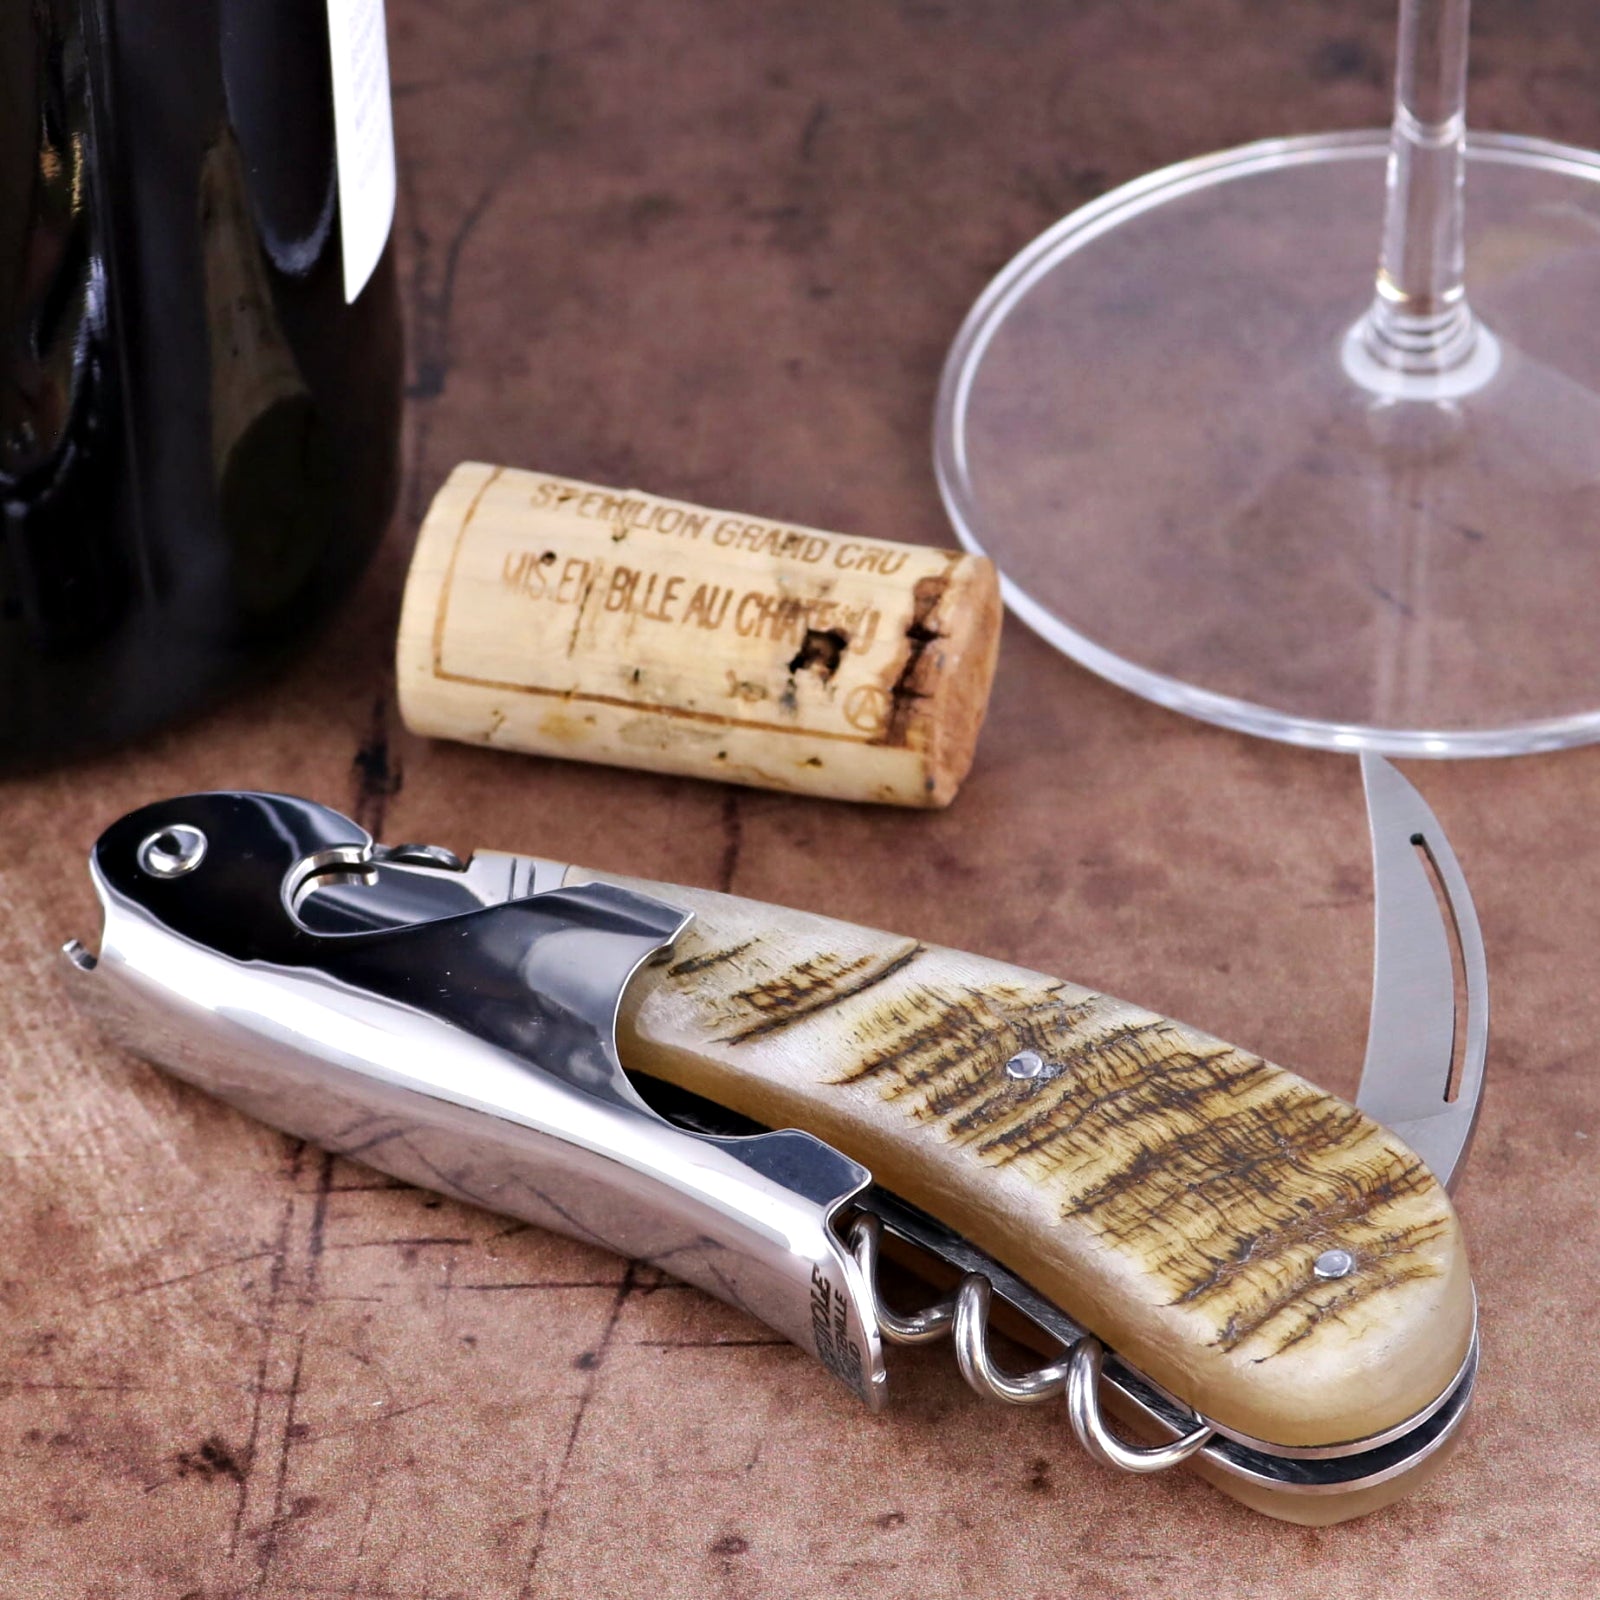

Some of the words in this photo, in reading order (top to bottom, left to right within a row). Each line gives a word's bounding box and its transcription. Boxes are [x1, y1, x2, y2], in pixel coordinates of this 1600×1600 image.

[712, 518, 830, 564] GRAND
[833, 542, 911, 576] CRU
[681, 582, 734, 631] AU
